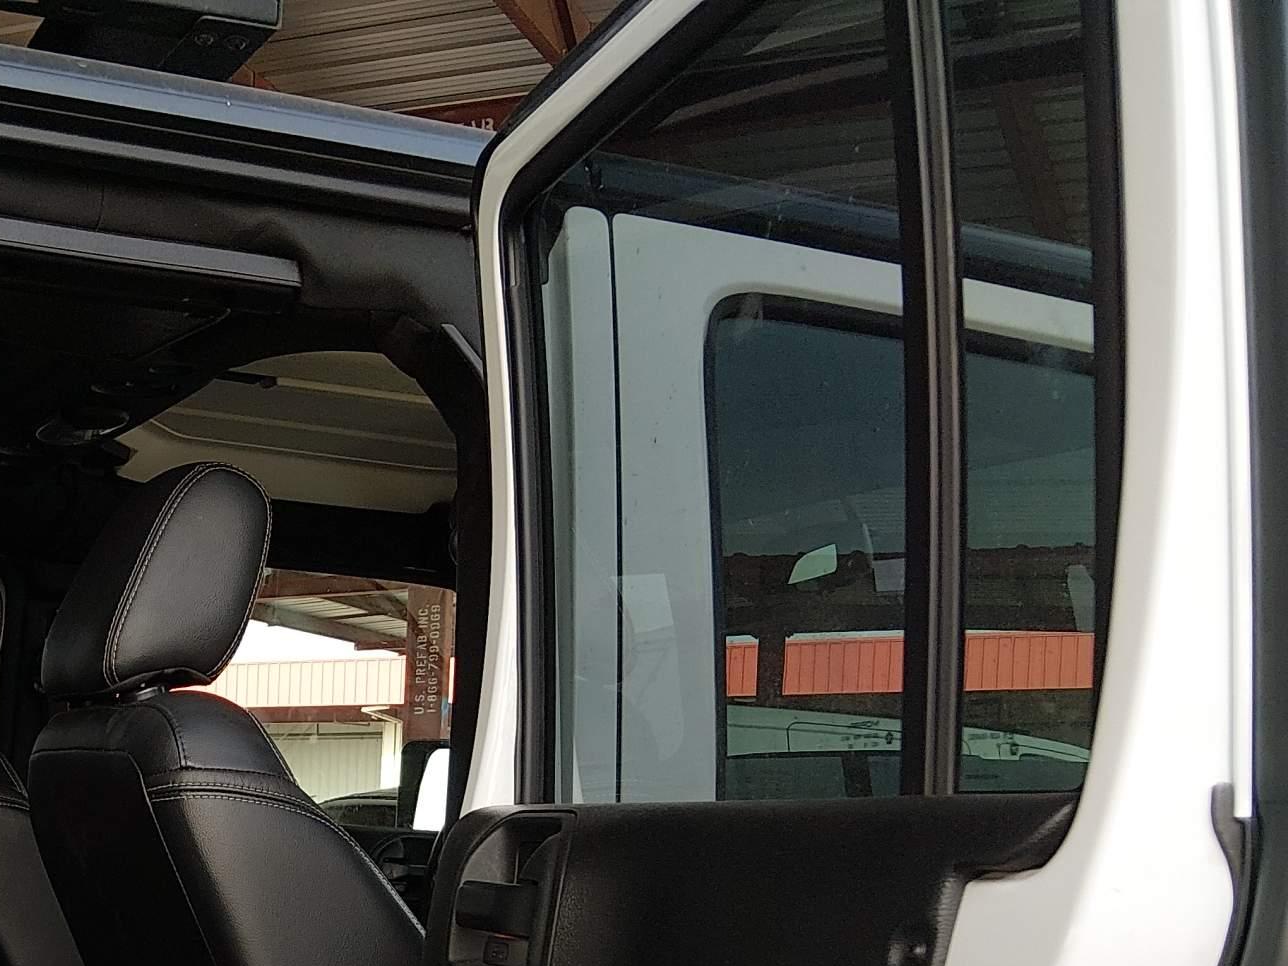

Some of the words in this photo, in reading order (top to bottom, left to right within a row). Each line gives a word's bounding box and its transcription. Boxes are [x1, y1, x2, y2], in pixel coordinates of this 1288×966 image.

[419, 604, 430, 631] INC.
[416, 634, 427, 684] PREFAB
[414, 690, 425, 715] U.S.
